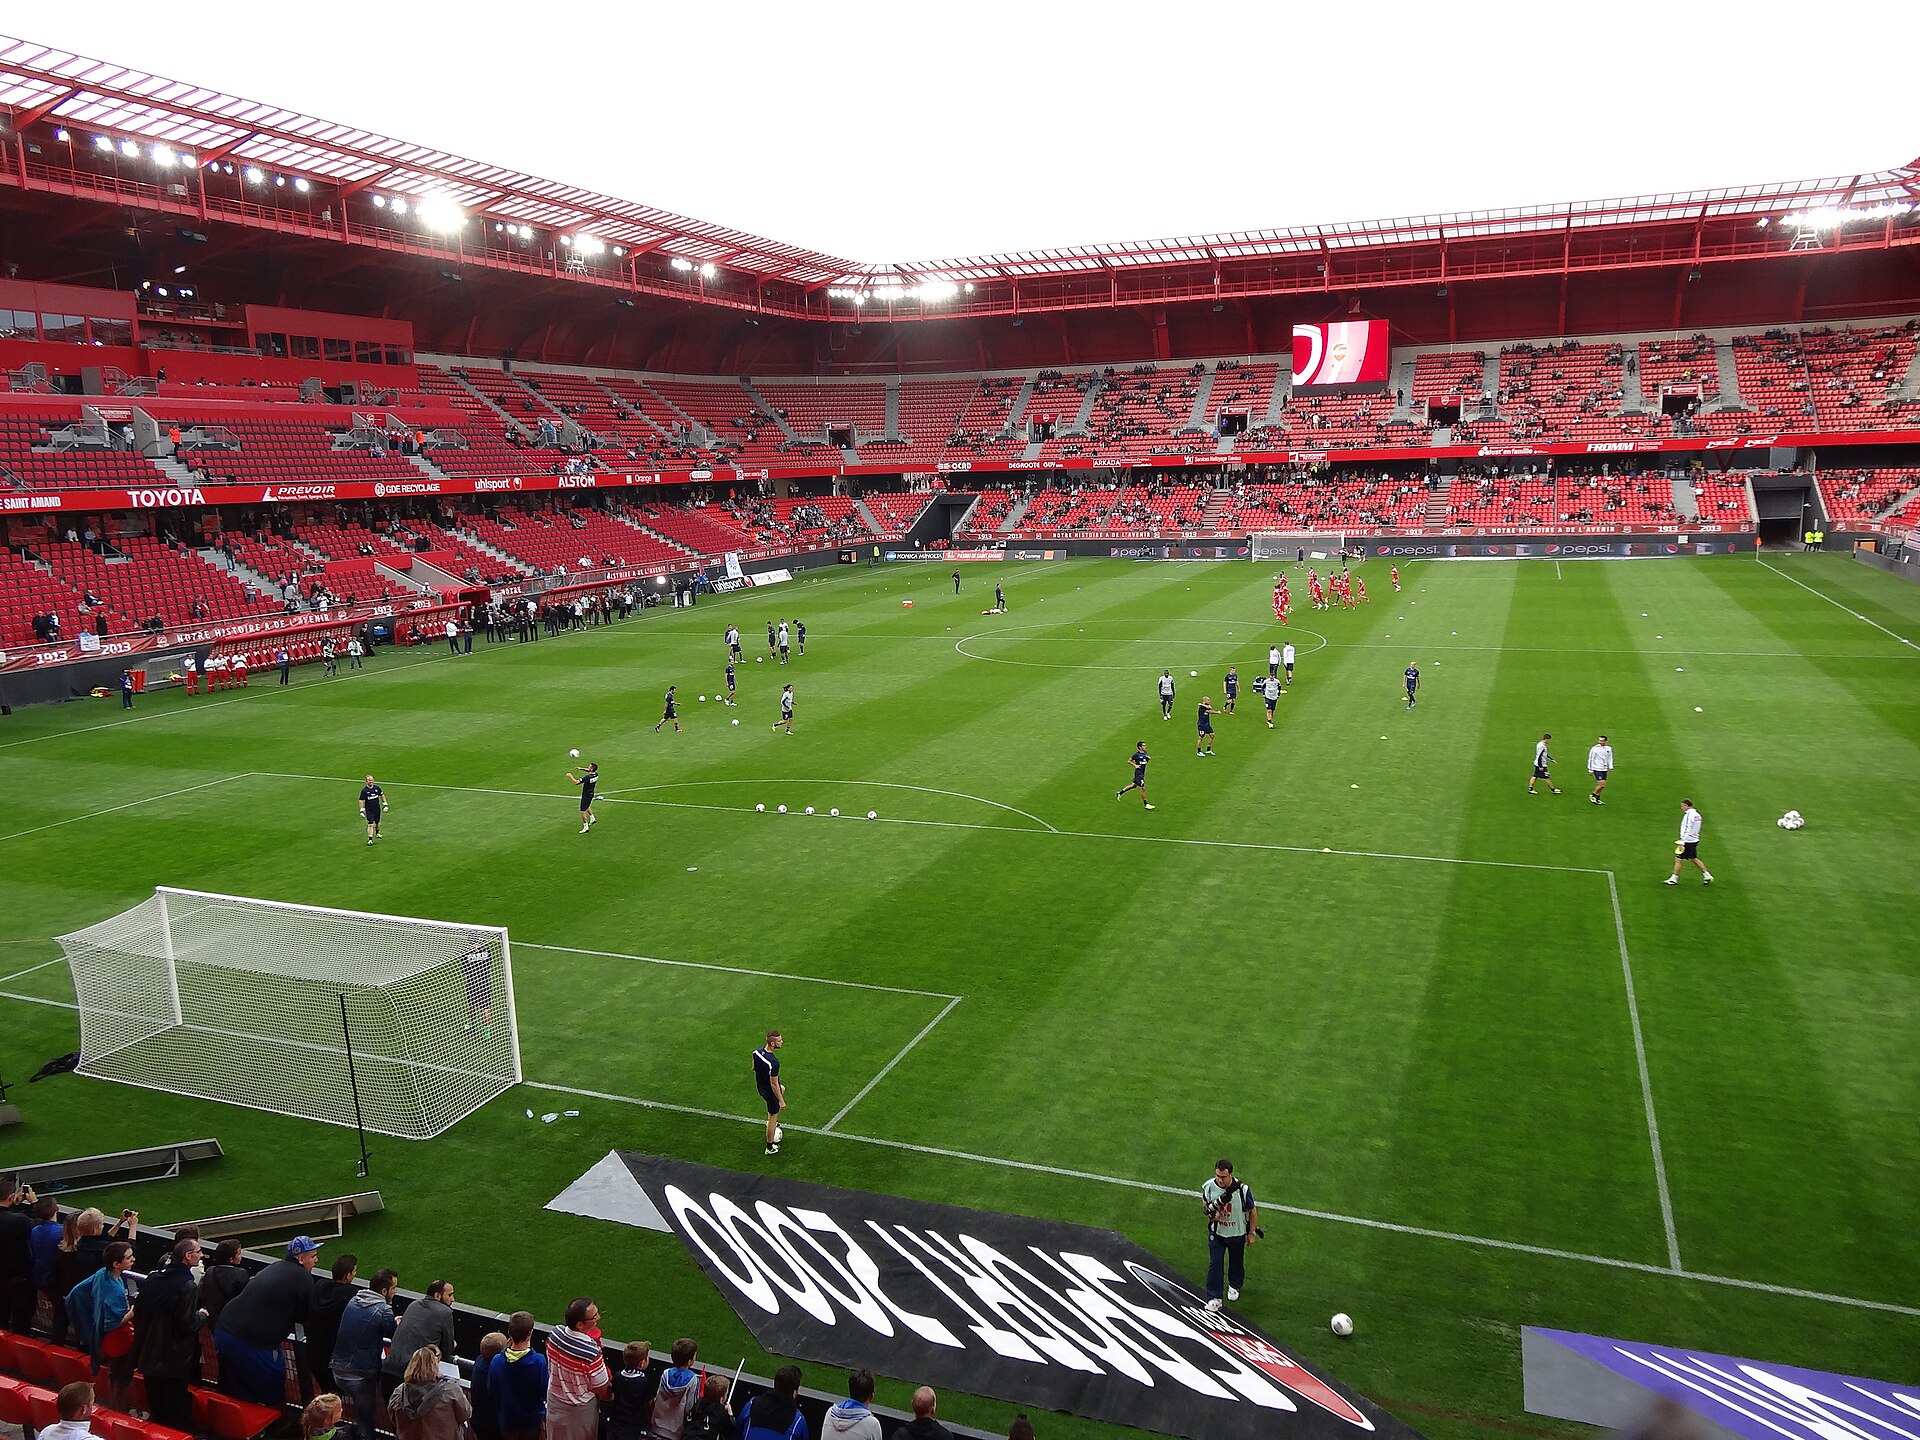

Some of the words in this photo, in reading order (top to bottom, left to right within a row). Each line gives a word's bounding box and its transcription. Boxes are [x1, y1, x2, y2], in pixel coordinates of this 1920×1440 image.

[1586, 442, 1634, 452] FROMM
[475, 478, 510, 491] uhlsport
[558, 475, 596, 488] ALSTOM
[634, 474, 653, 483] Orange
[386, 486, 401, 494] GDE
[402, 483, 440, 492] RECYCLAGE
[4, 499, 29, 509] SAINT
[30, 496, 62, 508] AMAND
[127, 489, 206, 507] TOYOTA
[1658, 525, 1678, 533] 1913
[1393, 546, 1436, 555] pepsi
[1562, 544, 1611, 554] pepsi
[715, 577, 744, 592] uhlsport
[176, 630, 211, 642] NOTRE
[214, 624, 261, 637] HISTOIRE
[273, 619, 286, 629] DE
[36, 651, 69, 665] 1913
[102, 641, 132, 655] 2013
[664, 1183, 967, 1350] 2000
[878, 1218, 1298, 1413] SPORT
[1180, 1304, 1245, 1336] 2000
[1219, 1334, 1295, 1368] SPORT
